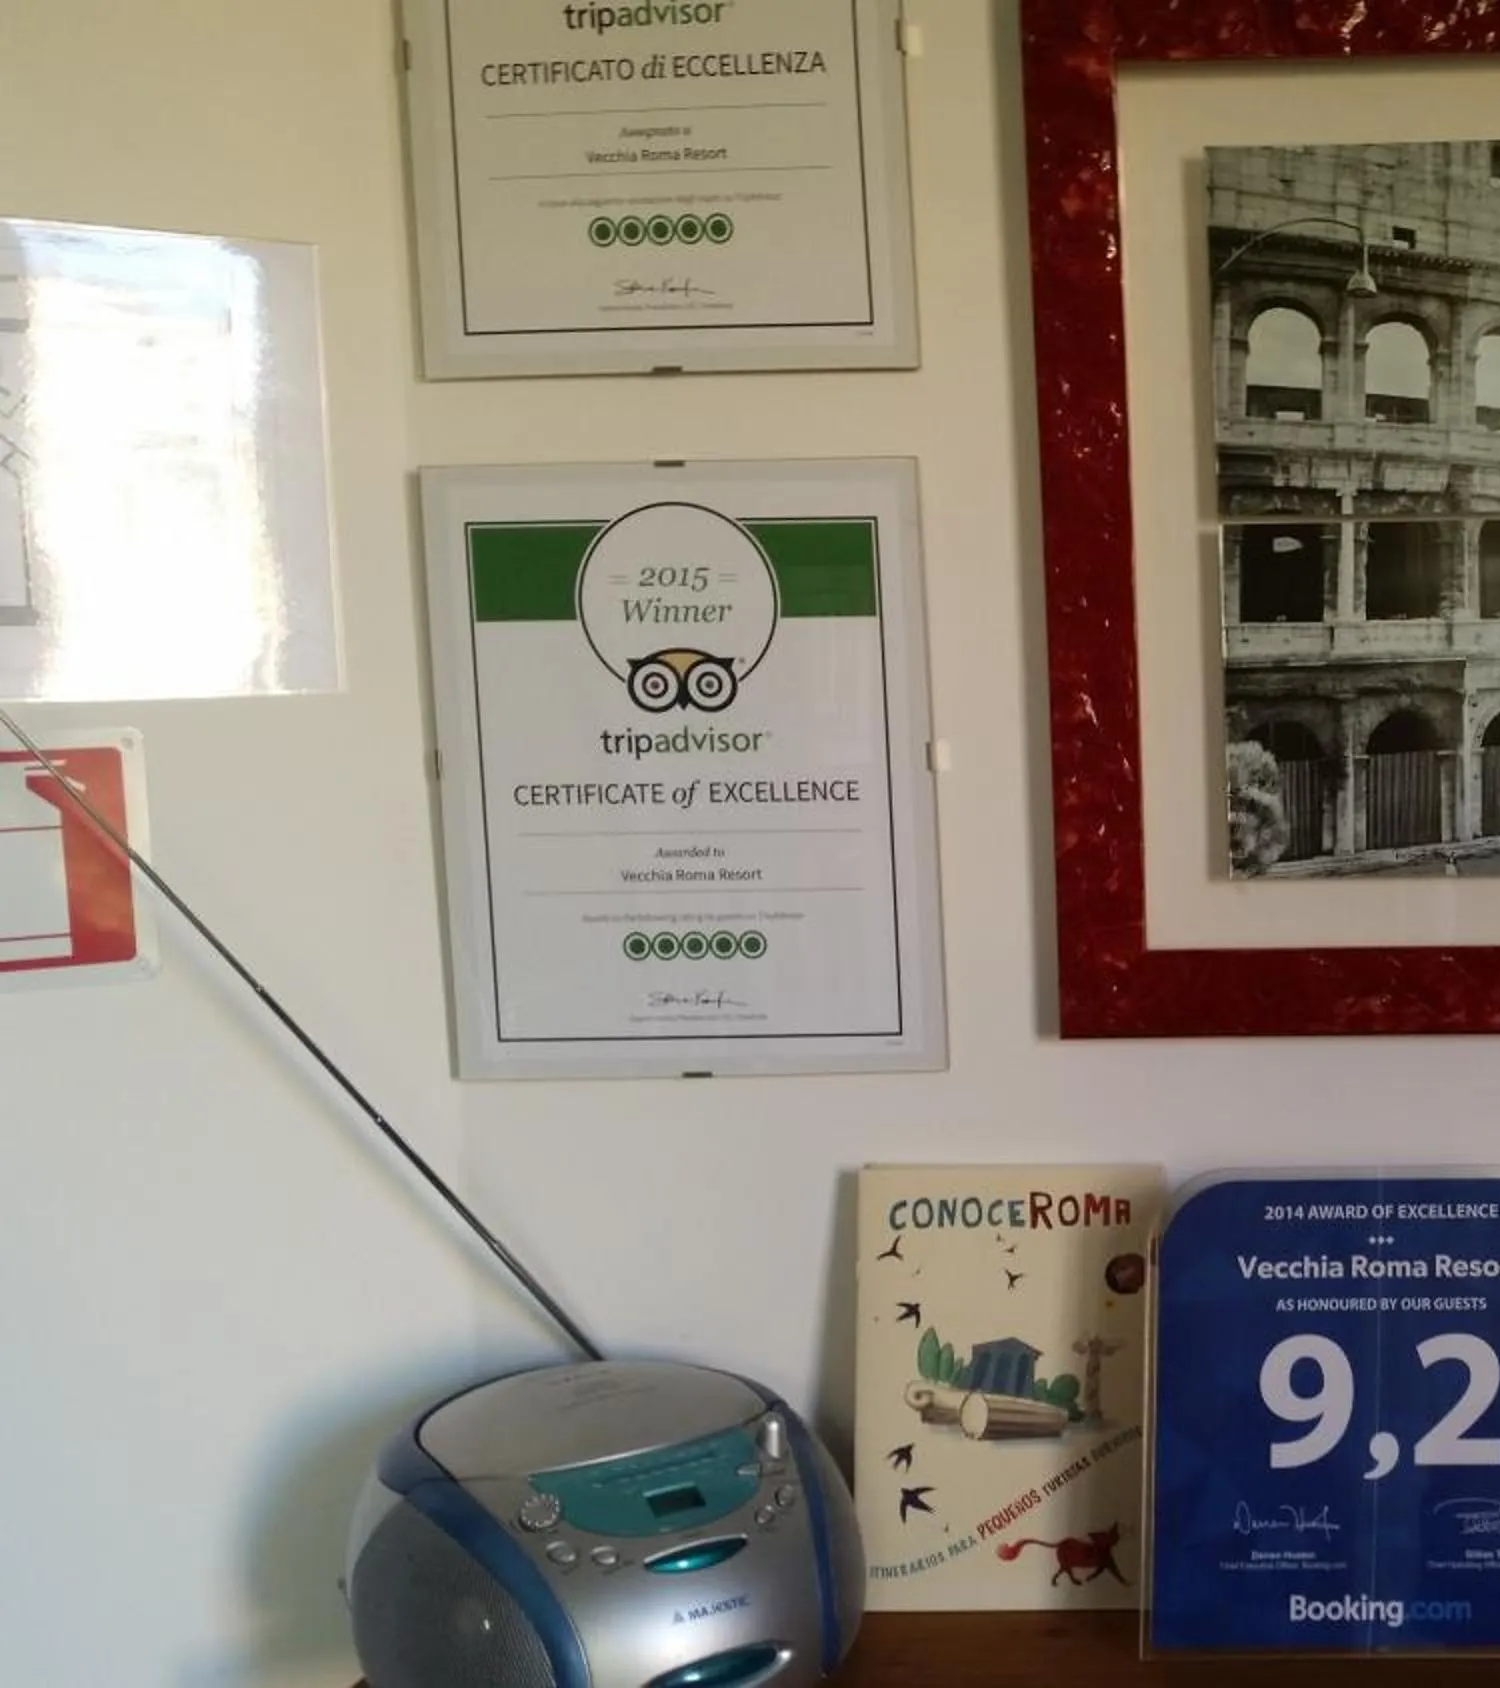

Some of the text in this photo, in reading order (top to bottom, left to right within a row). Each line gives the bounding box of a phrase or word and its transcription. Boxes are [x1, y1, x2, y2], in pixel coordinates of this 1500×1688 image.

[563, 0, 726, 35] tripadvisor
[481, 51, 827, 86] CERTIFICATO di ECCELLENZA
[585, 148, 727, 164] Vecchia Roma Resort
[639, 567, 711, 592] 2015
[622, 597, 732, 623] Winner
[601, 727, 763, 759] tripadvisor
[513, 780, 860, 808] CERTIFICATE of EXCELLENCE
[621, 867, 763, 882] Vecchia Roma Resort
[1264, 1203, 1500, 1220] 2014 AWARD OF EXCELLENCE
[1237, 1255, 1344, 1279] Vecchia
[1351, 1255, 1428, 1278] Roma
[1276, 1297, 1487, 1312] AS HONOURED BY OUR GUESTS
[1290, 1593, 1472, 1627] Booking.com
